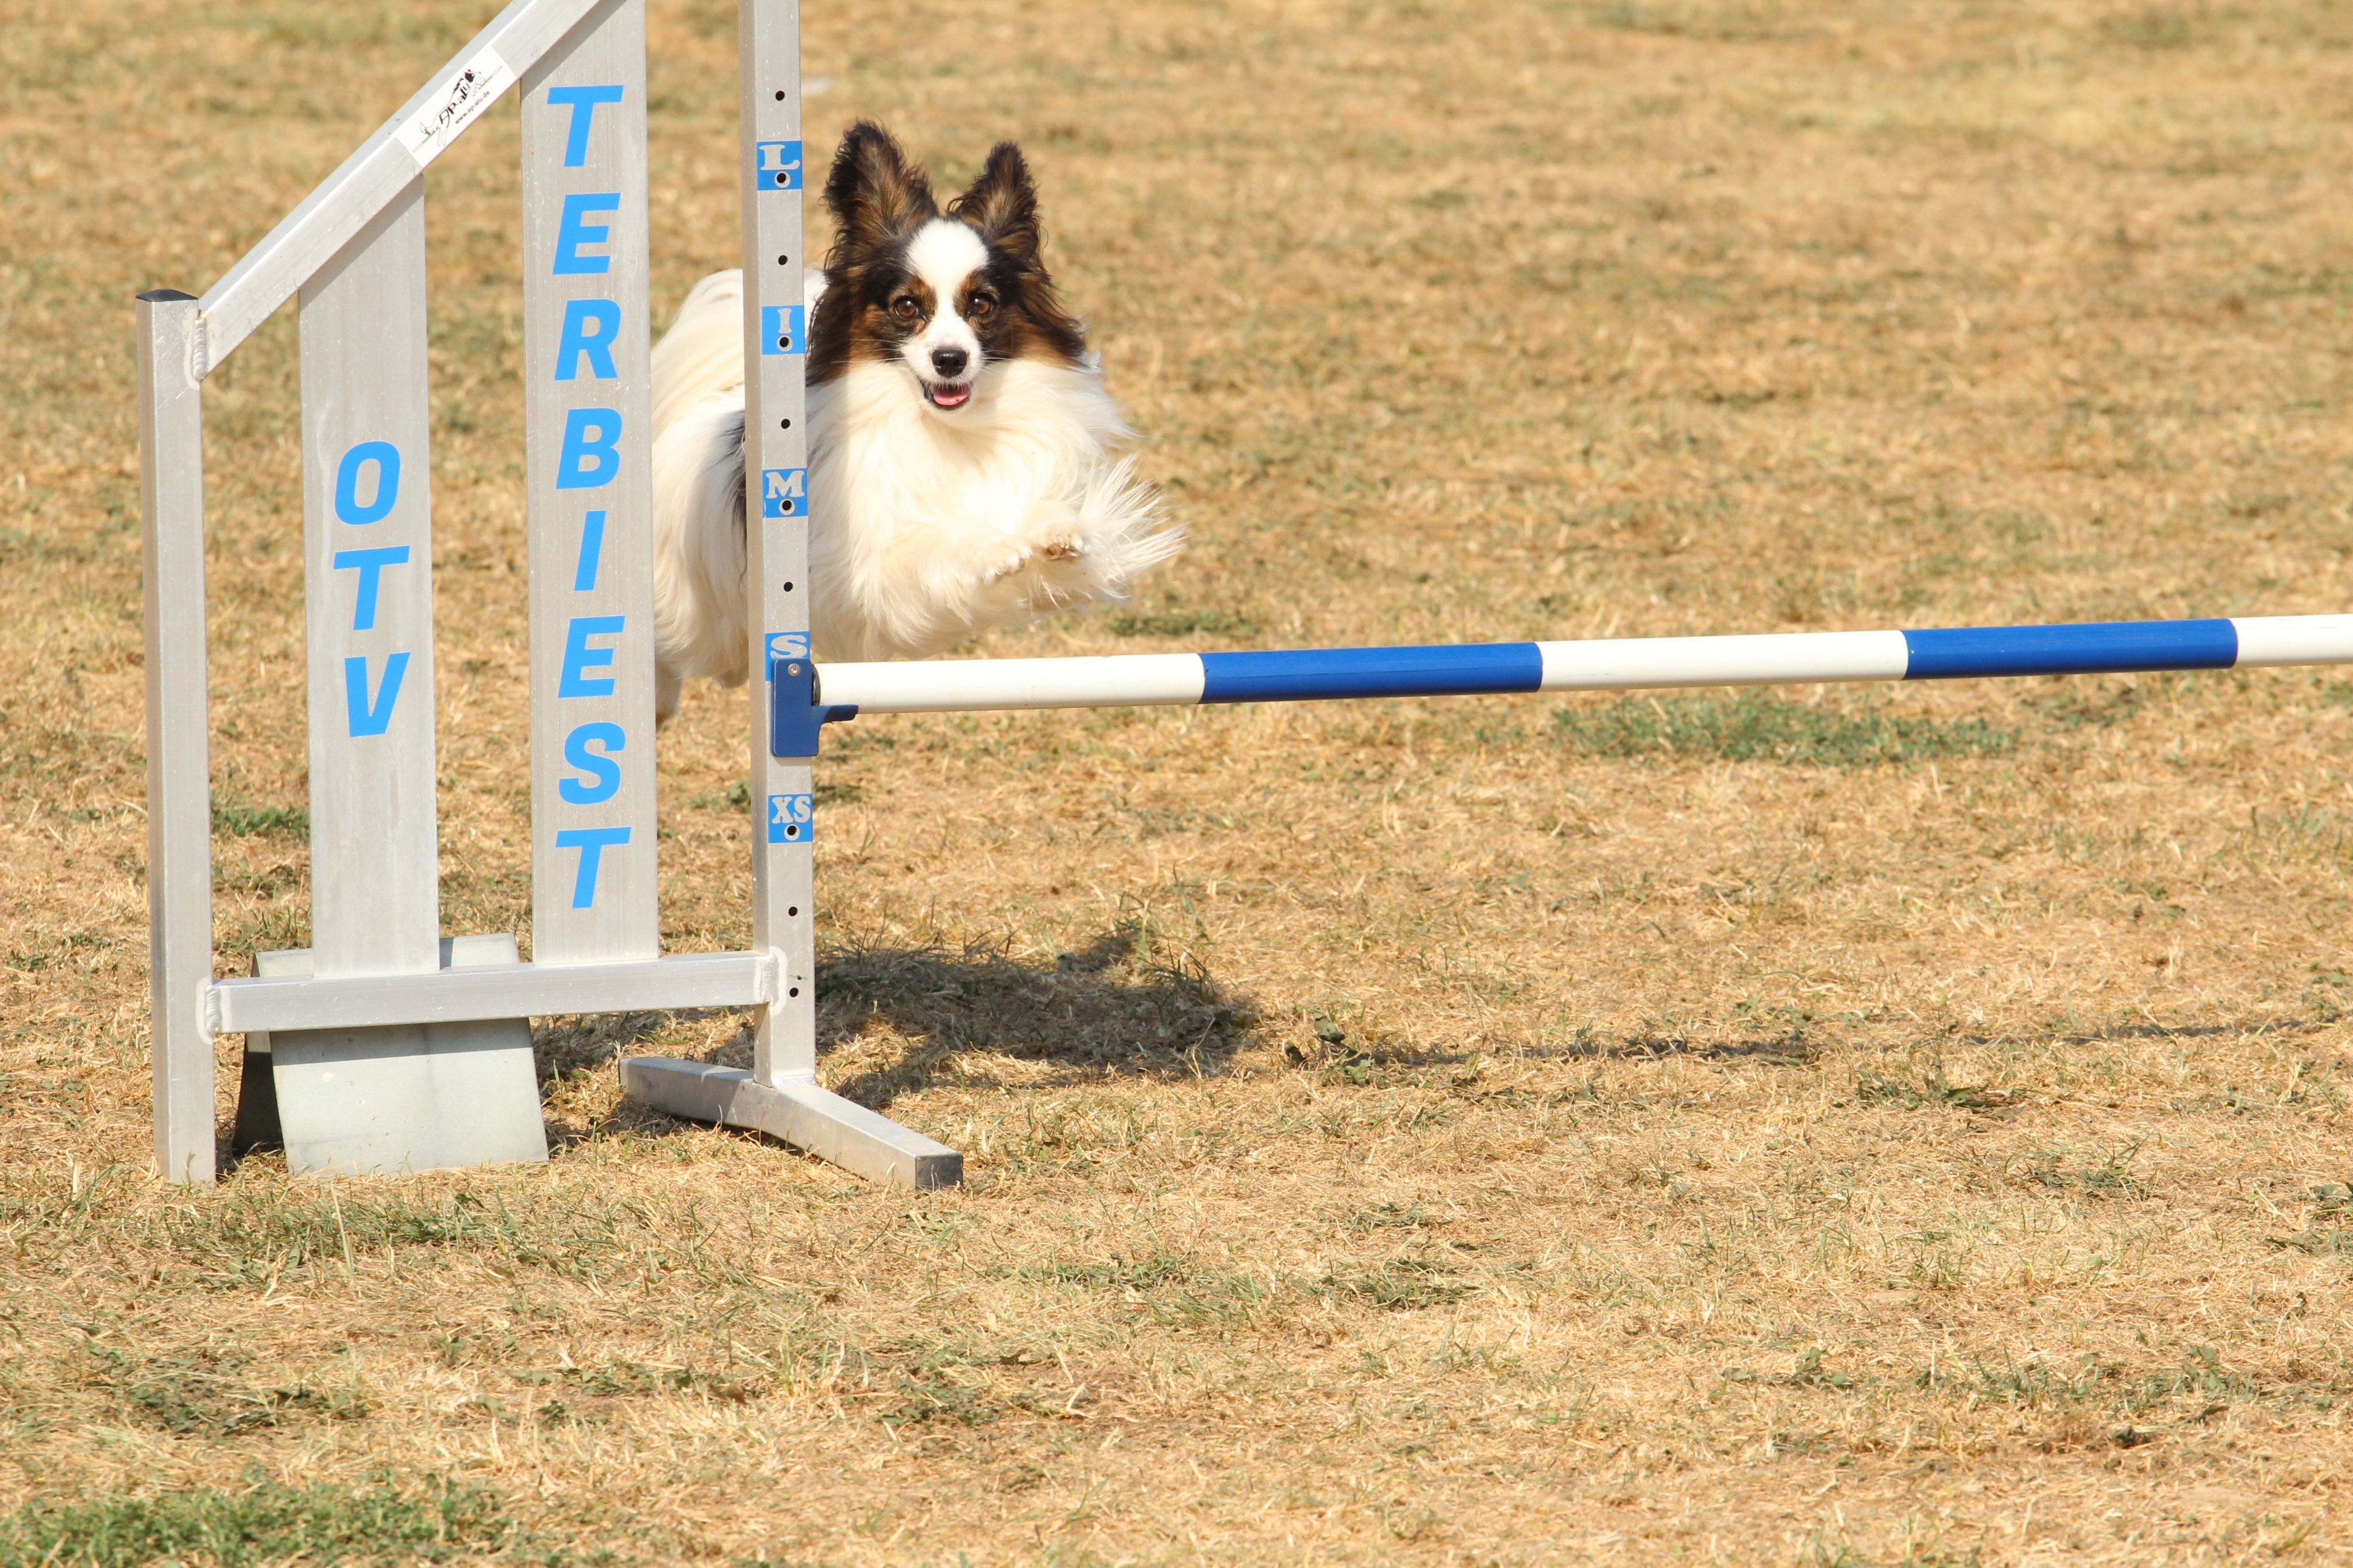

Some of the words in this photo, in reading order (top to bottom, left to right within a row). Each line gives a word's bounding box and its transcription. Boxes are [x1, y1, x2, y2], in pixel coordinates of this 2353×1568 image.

[454, 90, 490, 124] www.ap-alu.de
[759, 144, 800, 171] L
[547, 85, 631, 909] TERBIEST
[765, 470, 805, 498] M
[333, 441, 411, 737] OTV
[770, 634, 807, 659] S
[772, 796, 811, 824] XS
